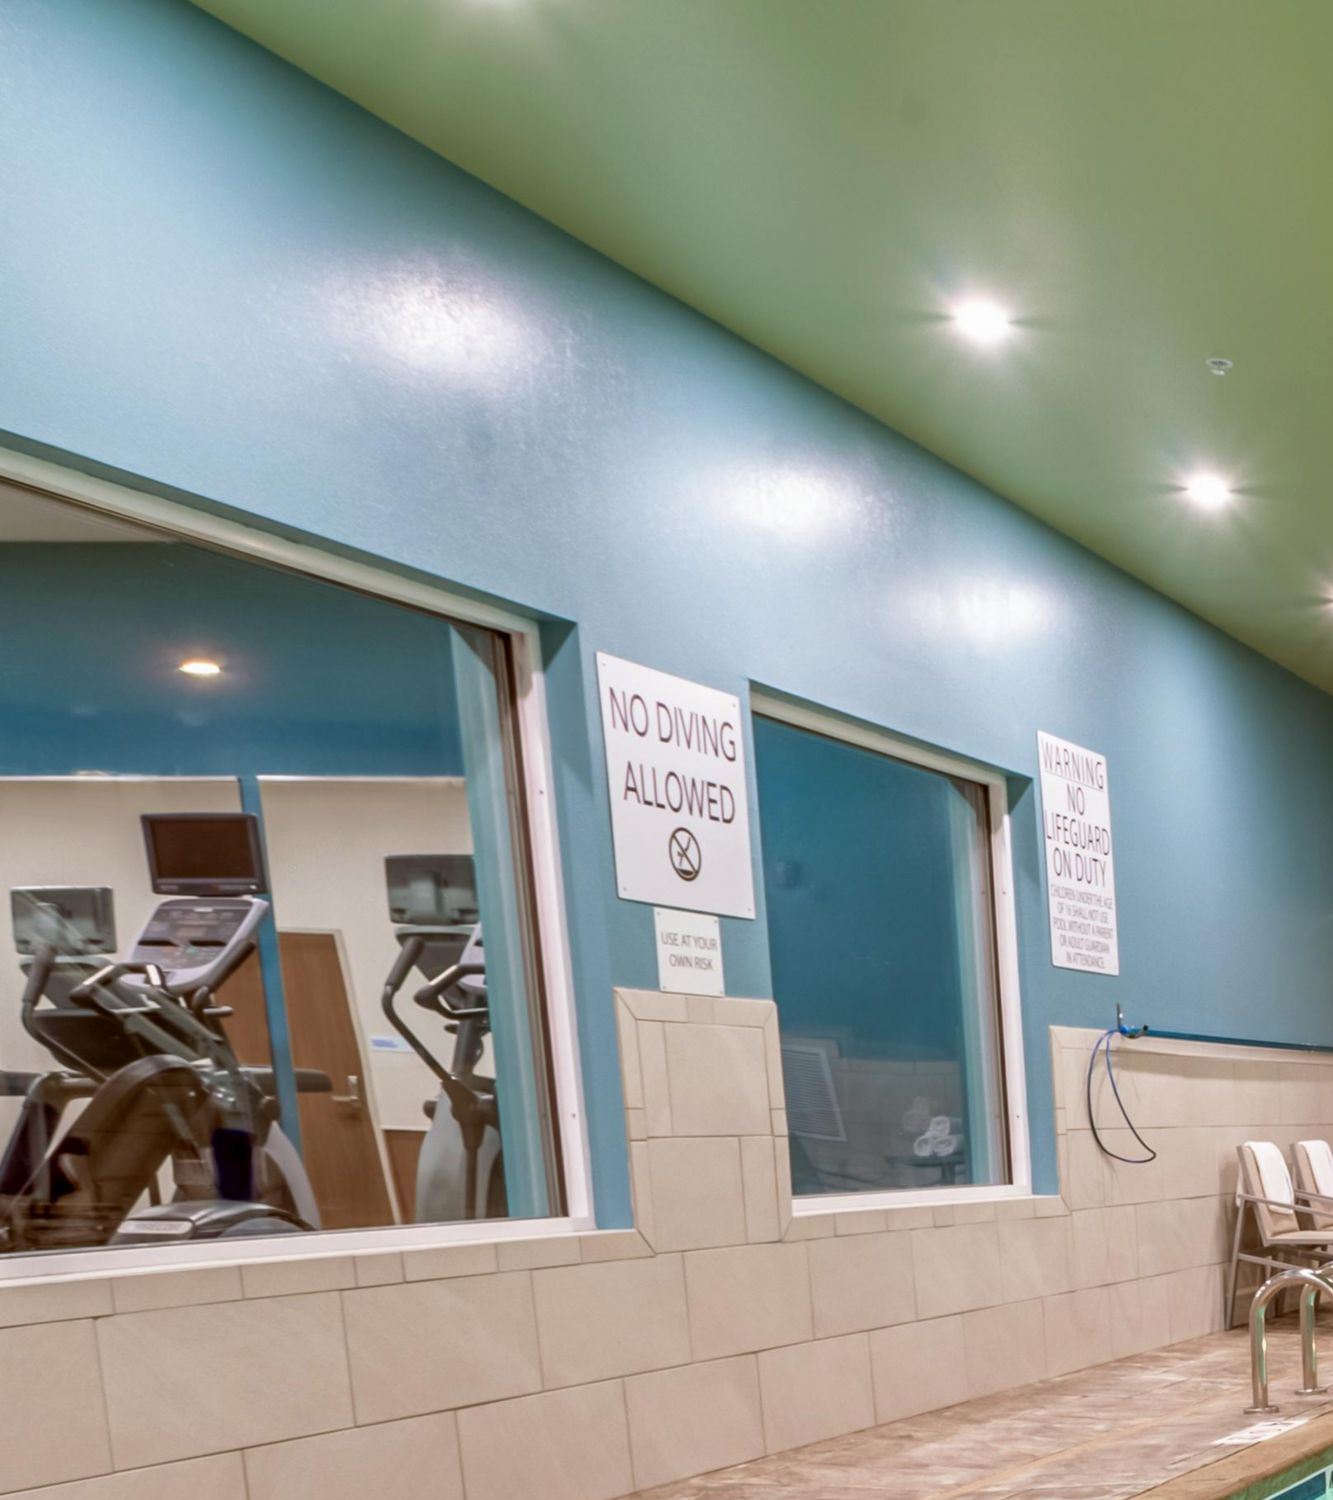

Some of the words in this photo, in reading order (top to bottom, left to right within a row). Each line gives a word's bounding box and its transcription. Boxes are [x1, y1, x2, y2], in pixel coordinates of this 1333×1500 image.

[609, 686, 649, 738] NO
[656, 701, 736, 762] DIVING
[1041, 739, 1104, 790] WARNING
[624, 760, 735, 824] ALLOWED
[1067, 783, 1085, 816] NO
[1044, 809, 1110, 856] LIFEGUARD
[1053, 847, 1072, 880] ON
[1075, 853, 1106, 888] DUTY
[661, 931, 680, 947] USE
[681, 934, 691, 948] AT
[692, 936, 718, 951] YOUR
[669, 953, 693, 968] OWN
[695, 956, 714, 971] RISK
